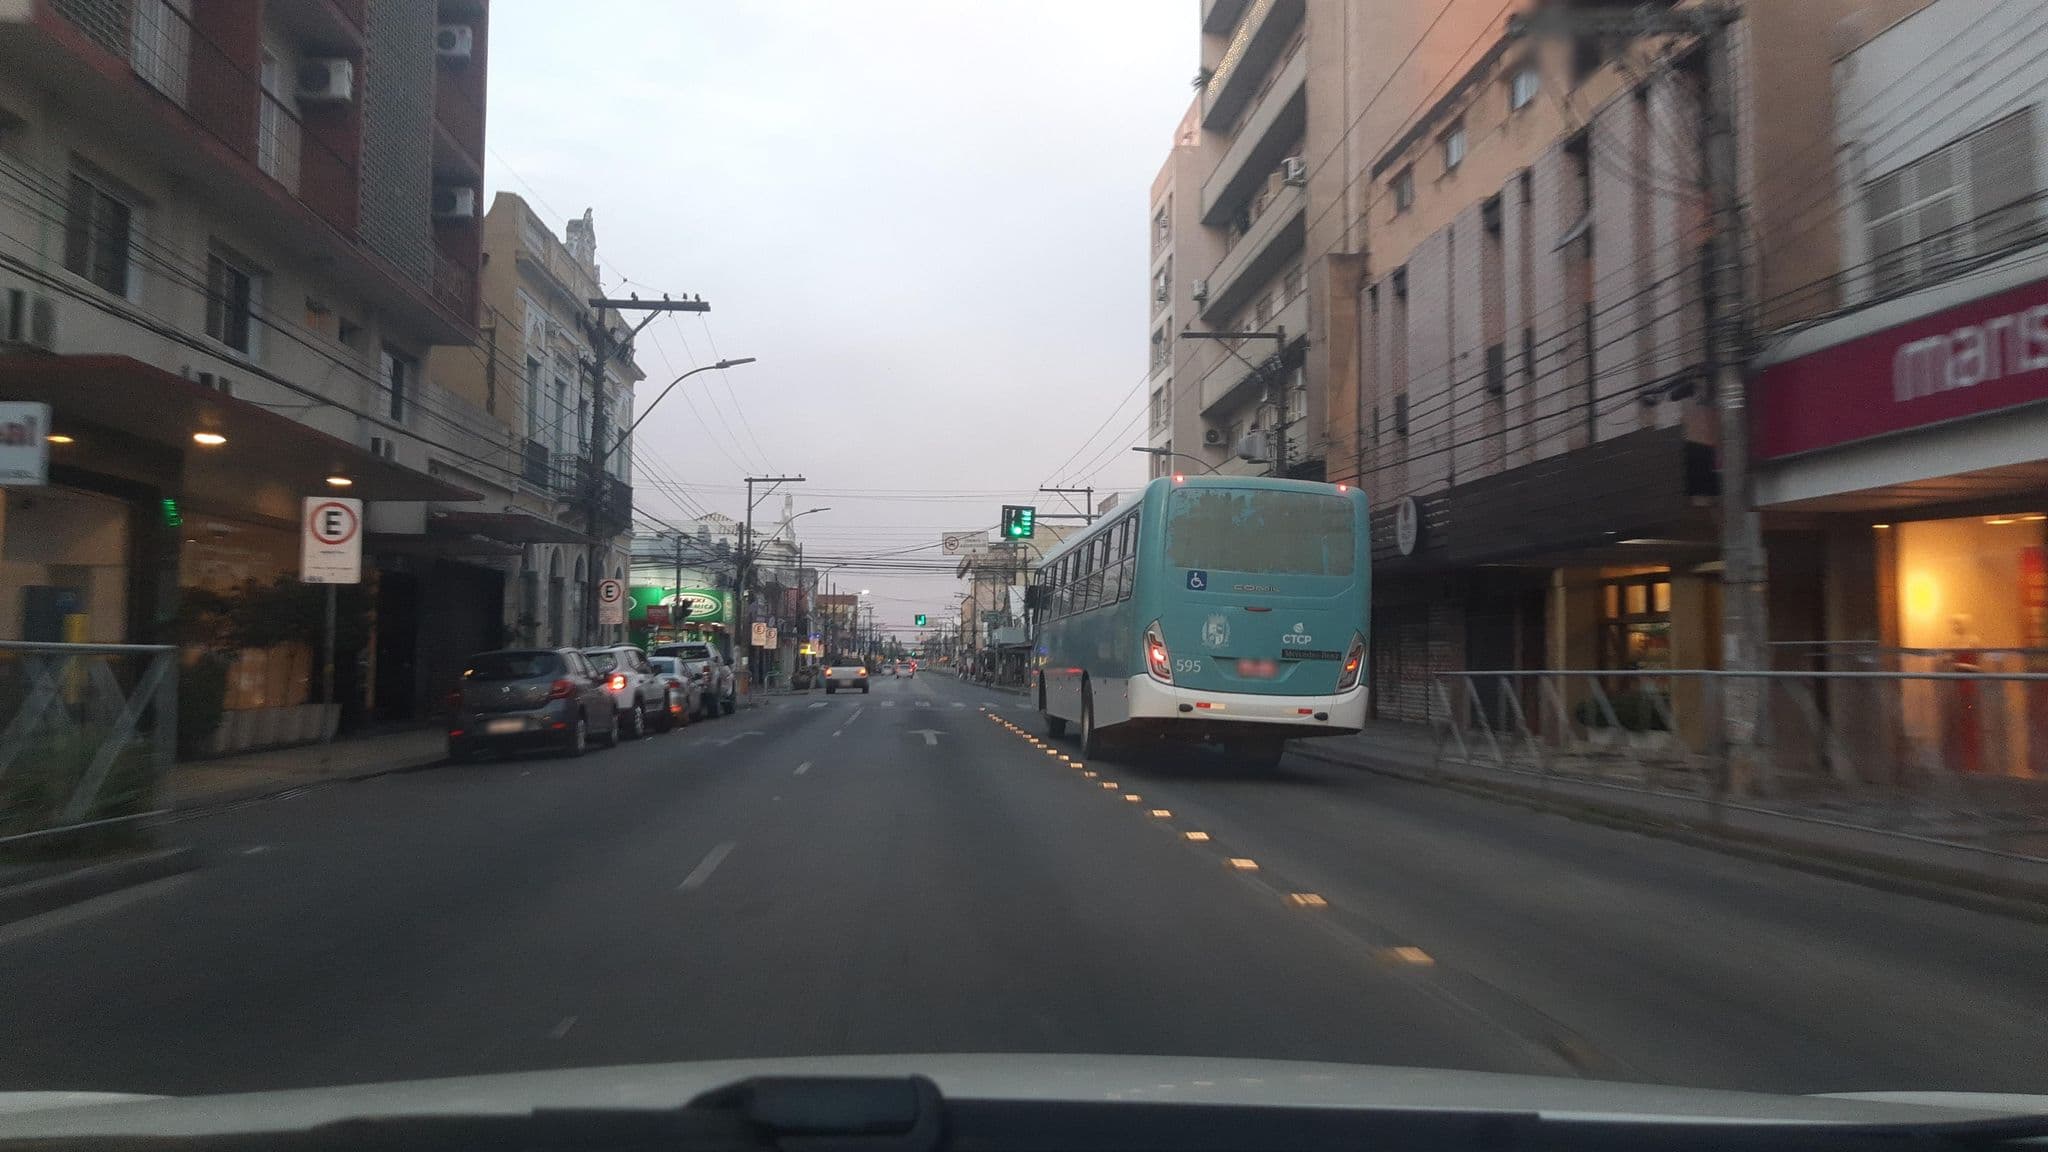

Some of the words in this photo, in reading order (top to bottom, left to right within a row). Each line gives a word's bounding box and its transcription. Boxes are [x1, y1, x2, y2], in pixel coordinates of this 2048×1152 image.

[325, 511, 342, 535] E
[606, 585, 613, 598] E
[1282, 634, 1312, 645] CTCP
[1176, 659, 1201, 673] 595
